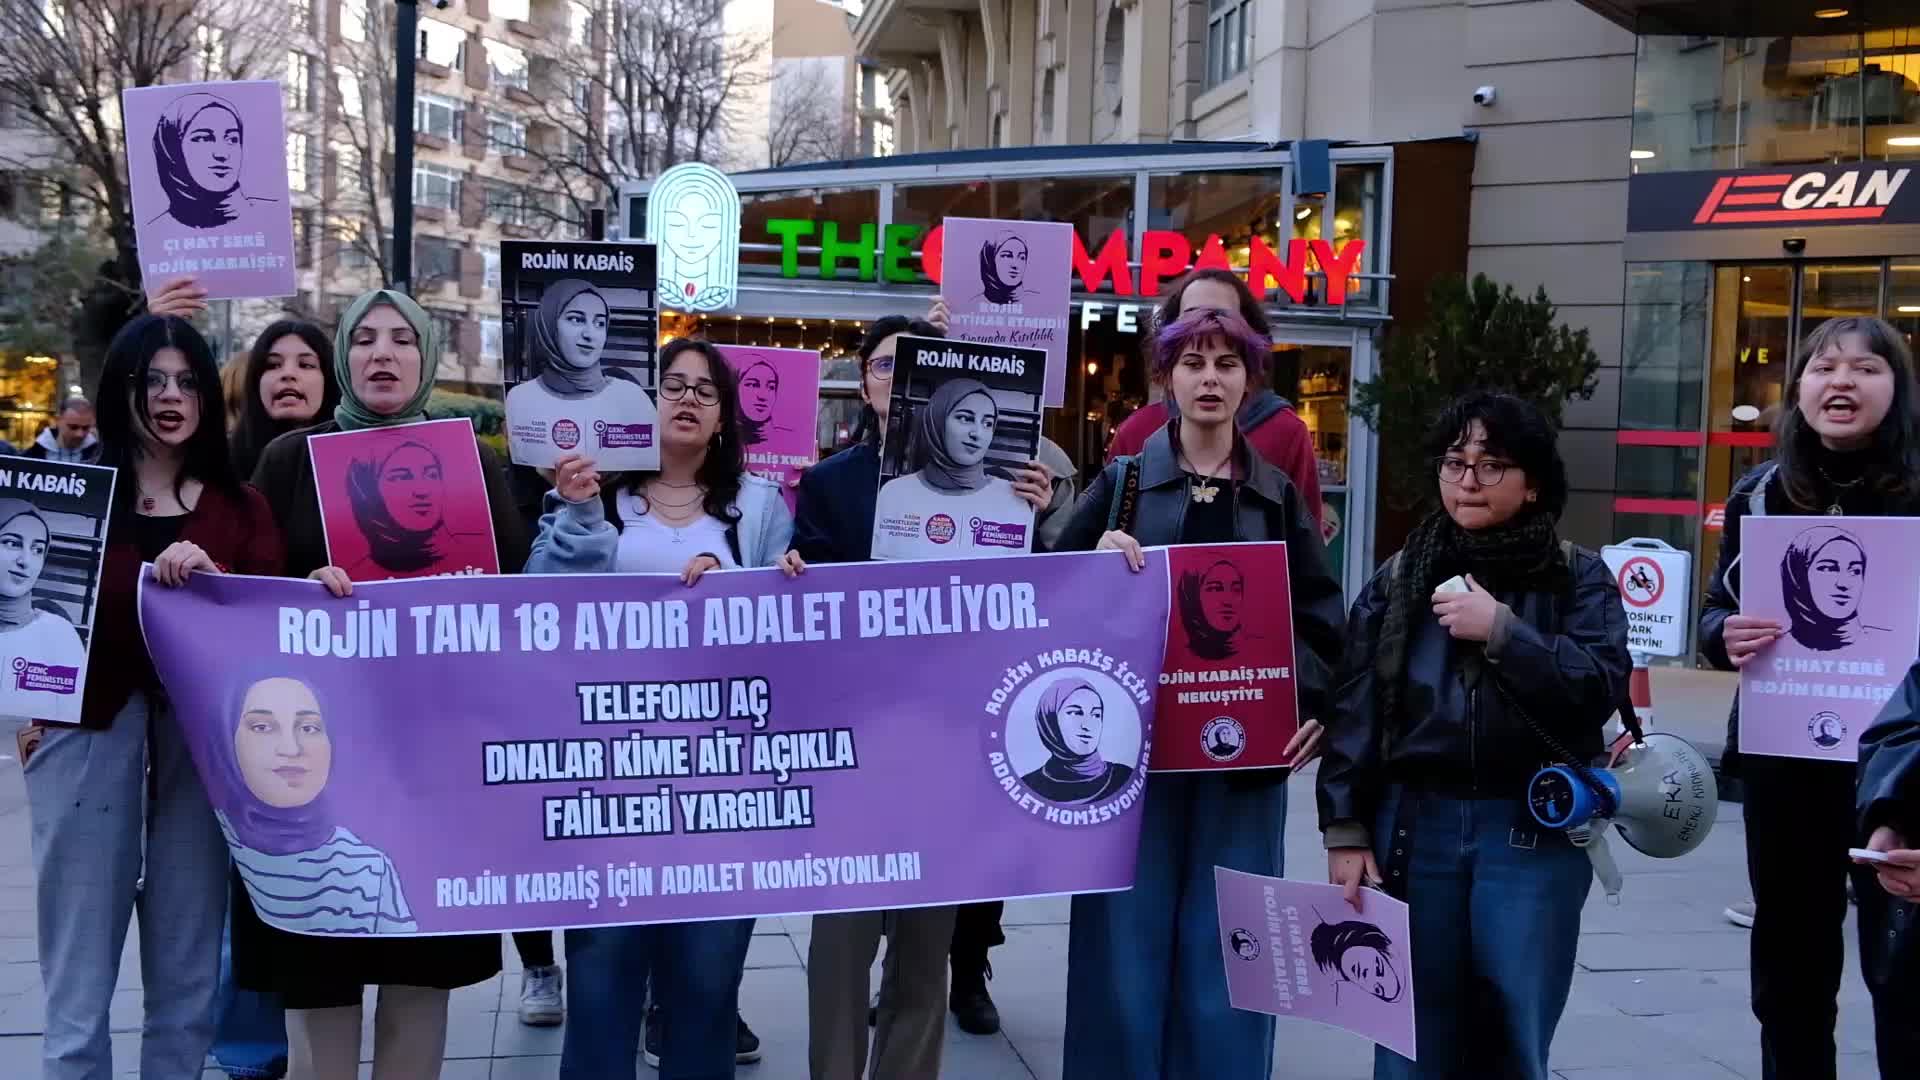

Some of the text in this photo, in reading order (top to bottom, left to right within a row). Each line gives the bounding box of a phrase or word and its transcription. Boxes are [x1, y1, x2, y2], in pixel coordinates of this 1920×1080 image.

[522, 249, 634, 272] ROJİN KABAİŞ
[766, 218, 1366, 305] THE MPANY
[917, 348, 1025, 376] ROJİN KABAİŞ
[17, 472, 86, 498] KABAİŞ
[279, 576, 1048, 658] ROJİN TAM 18 AYDIR ADALET BEKLİYOR.
[1626, 611, 1674, 625] OSİKLET
[1629, 626, 1652, 634] ARK
[1628, 636, 1662, 648] MEYİN!
[985, 648, 1150, 716] ROJİN KABAİŞ İÇİN
[1158, 668, 1195, 684] OJÎN
[1256, 667, 1290, 680] XWE
[578, 679, 768, 727] TELEFONU AÇ
[486, 730, 854, 782] DNALAR KİME AİT AÇIKLA
[988, 740, 1152, 825] ADALET KOMİSYONLARI
[546, 787, 812, 838] FAİLLERİ YARGILA!
[436, 852, 920, 908] ROJİN KABAİŞ İÇİN ADALET KOMİSYONLARI
